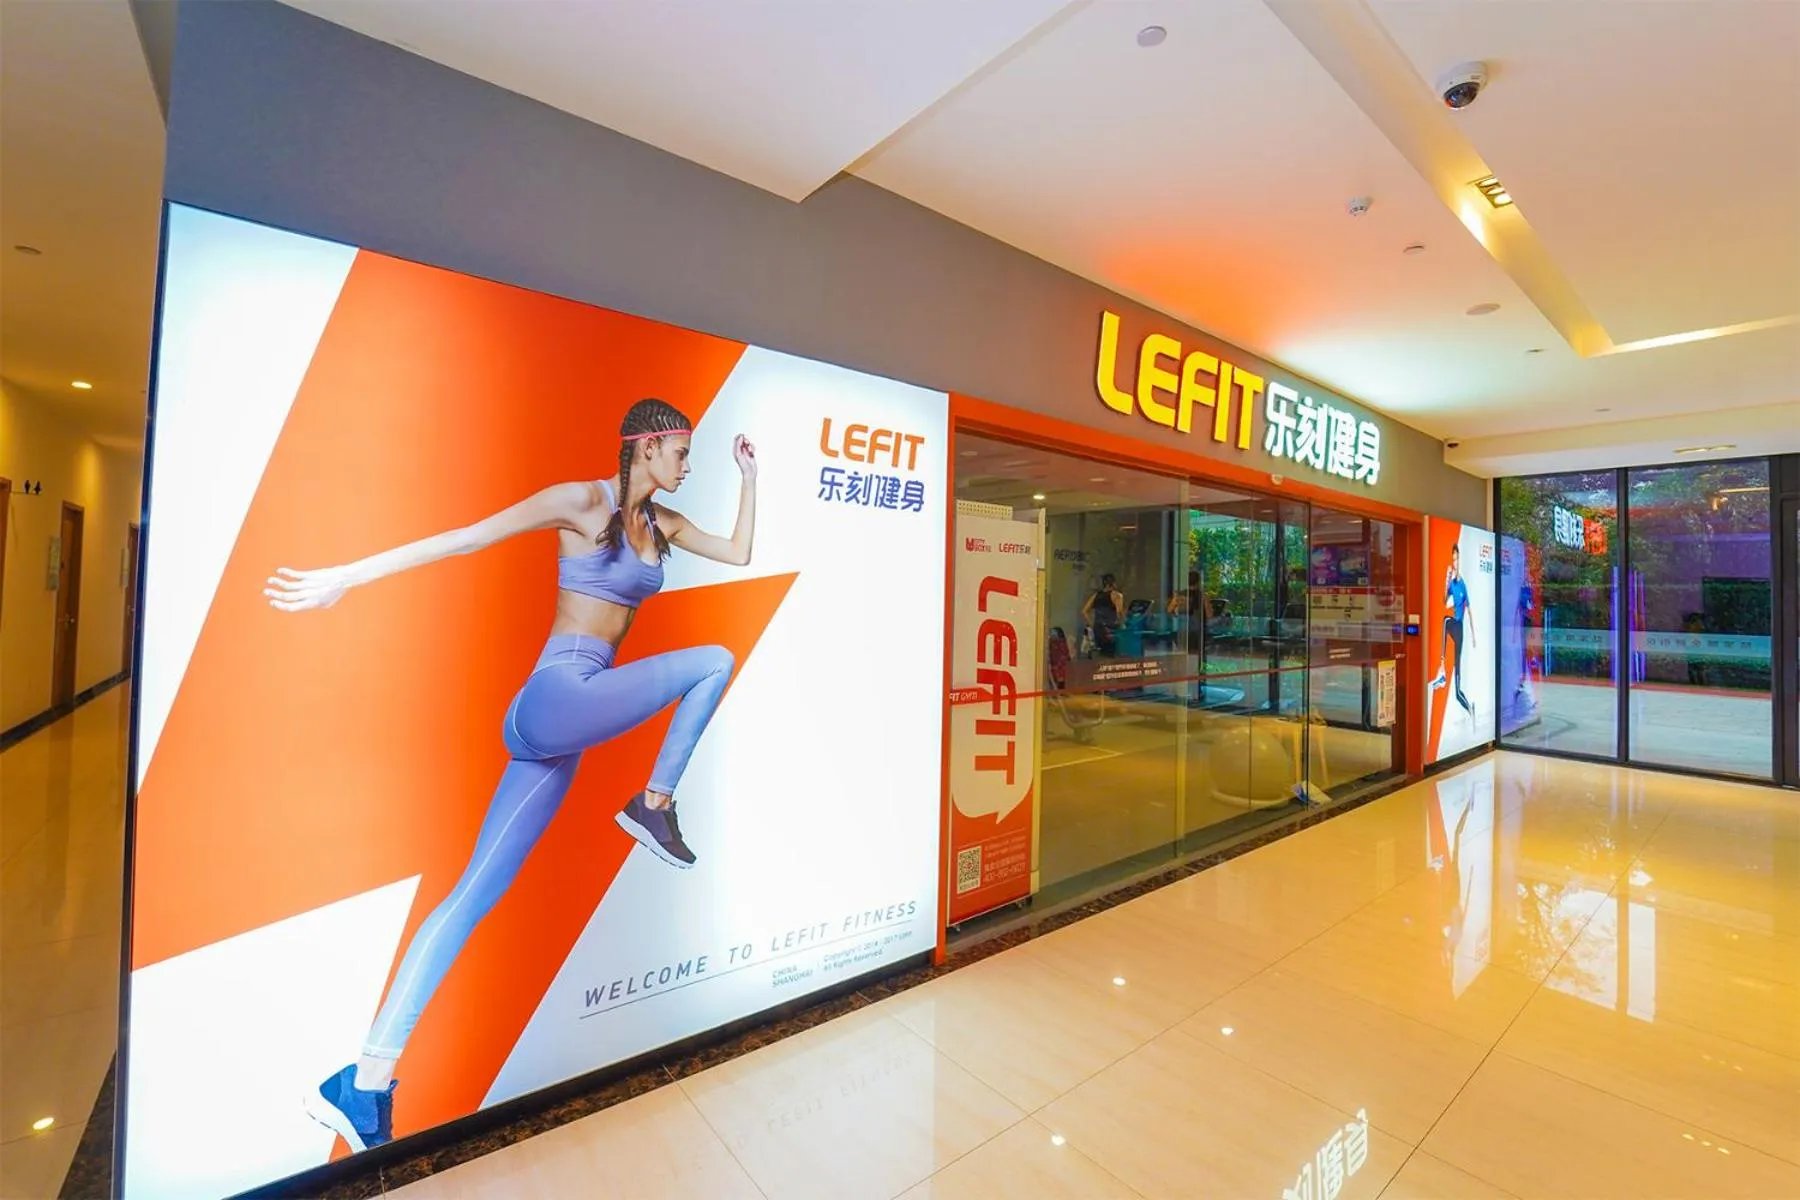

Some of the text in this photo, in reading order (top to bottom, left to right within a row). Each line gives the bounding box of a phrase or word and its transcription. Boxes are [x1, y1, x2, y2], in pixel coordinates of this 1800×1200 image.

[1096, 309, 1381, 486] LEFIT 乐刻健身
[819, 417, 925, 471] LEFIT
[818, 466, 925, 512] 乐刻健身
[975, 574, 1018, 786] LEFIT
[584, 900, 917, 1008] WELCOME TO LEFIT FITNESS
[772, 964, 798, 979] CHINA
[772, 969, 813, 988] SHANGHAI
